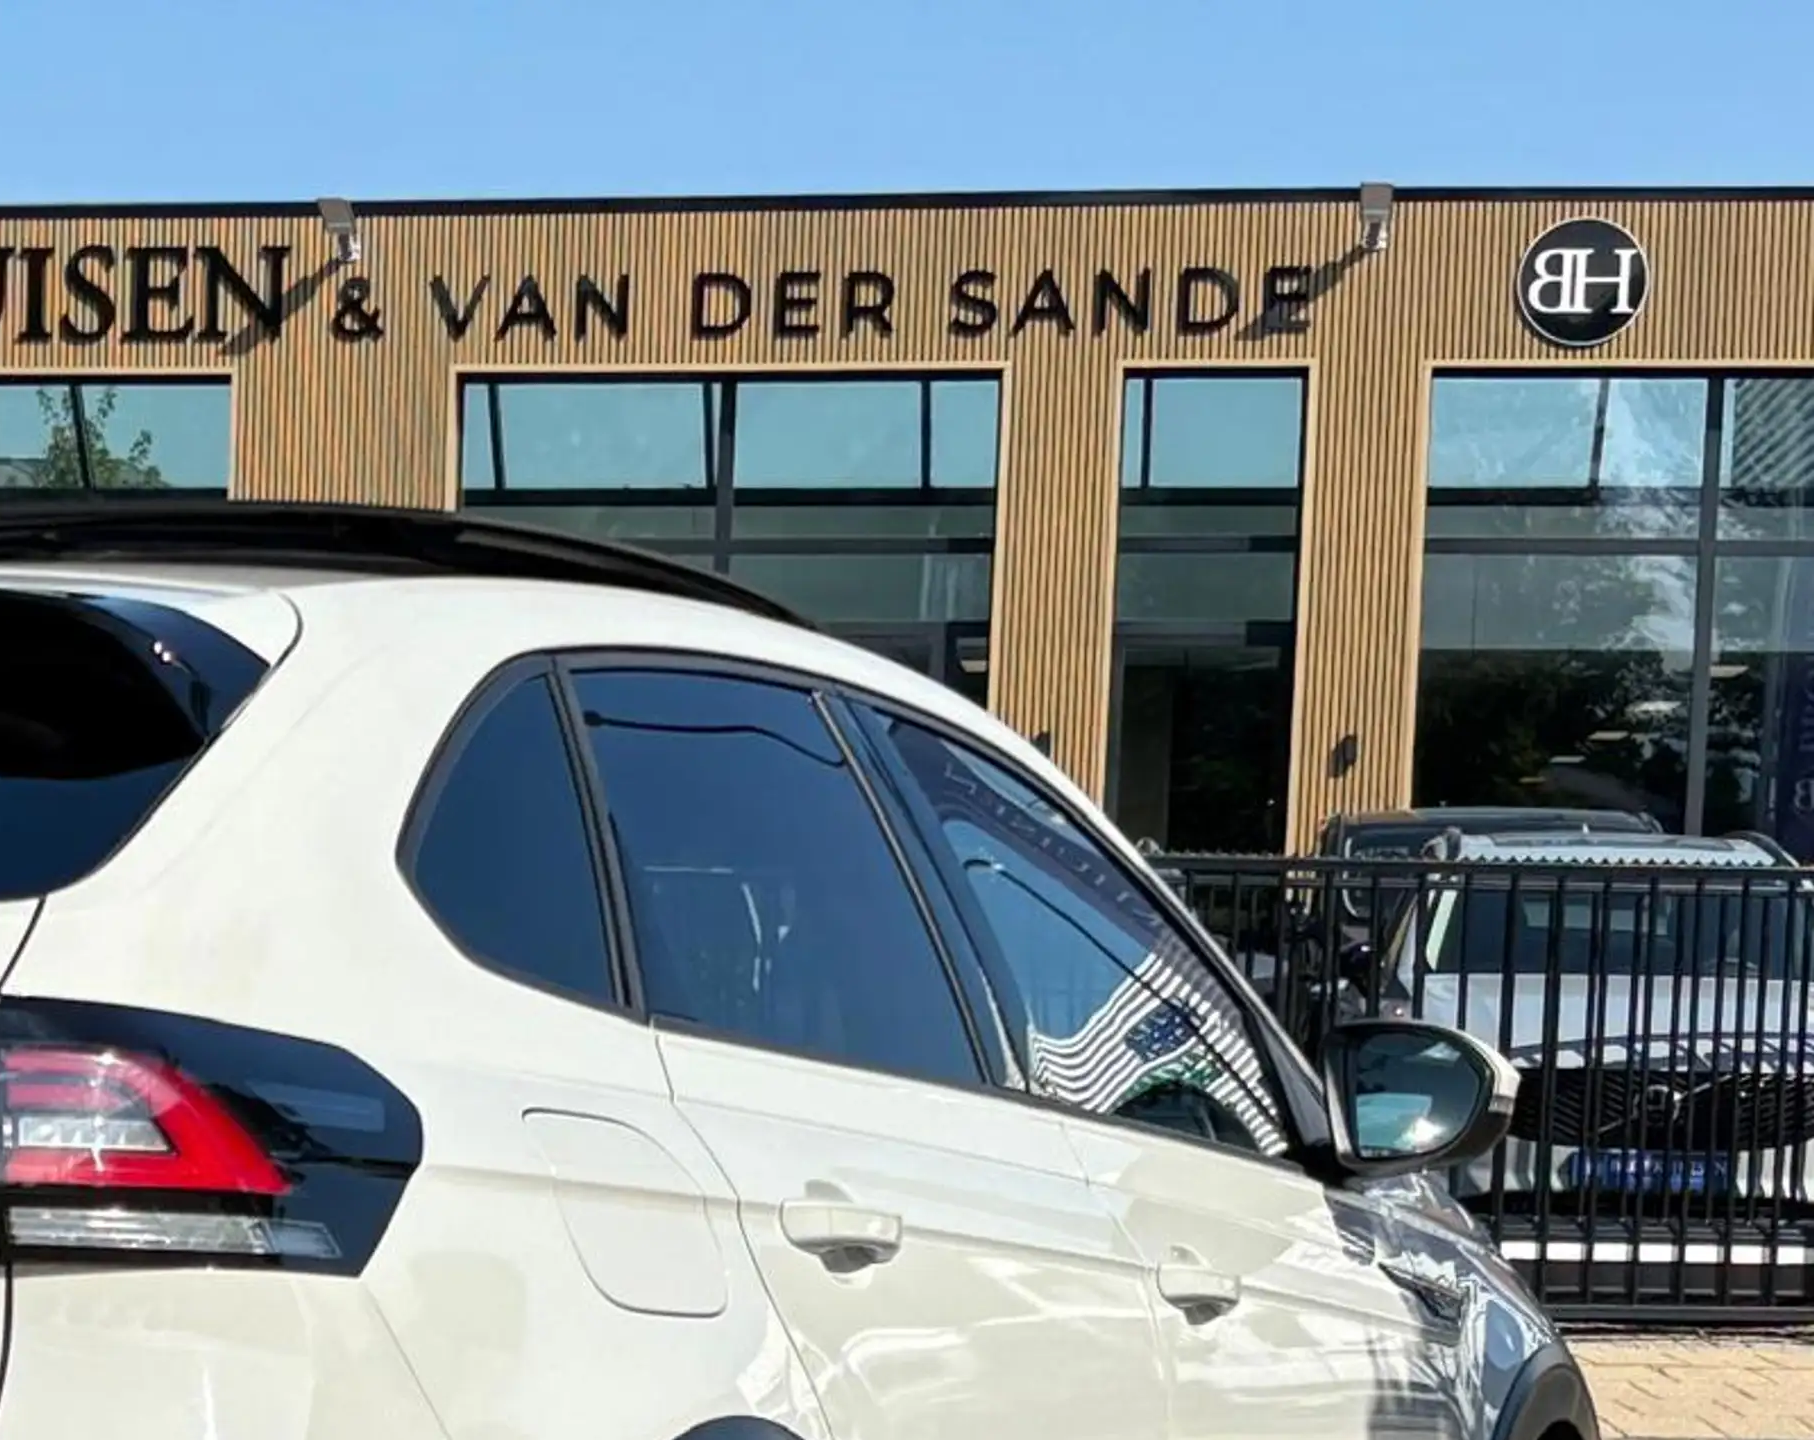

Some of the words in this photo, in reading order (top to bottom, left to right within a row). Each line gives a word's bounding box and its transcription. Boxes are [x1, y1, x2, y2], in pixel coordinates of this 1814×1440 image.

[330, 276, 385, 343] &
[430, 273, 630, 342] VAN
[691, 271, 895, 340] DER
[948, 265, 1312, 338] SANDE
